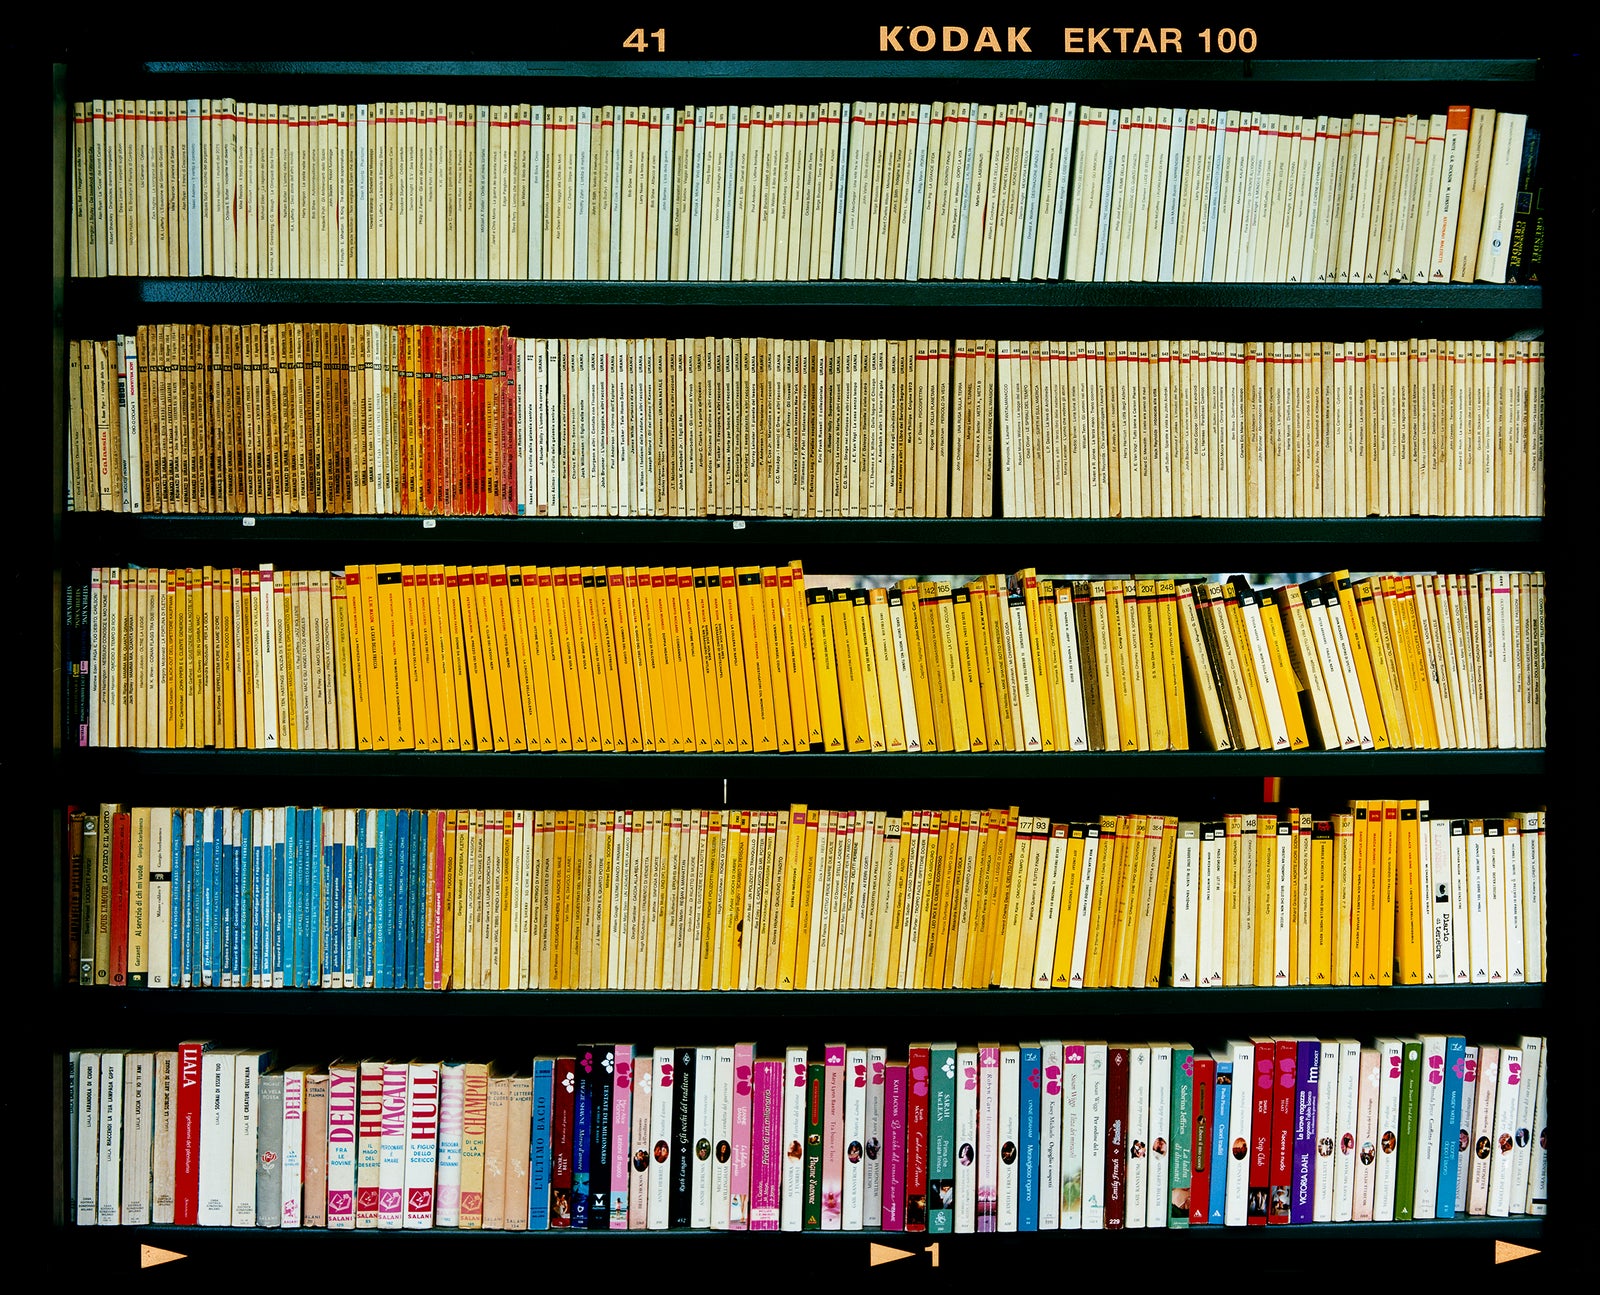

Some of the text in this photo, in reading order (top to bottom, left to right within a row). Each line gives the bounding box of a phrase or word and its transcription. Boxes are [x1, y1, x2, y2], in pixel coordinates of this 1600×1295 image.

[623, 29, 667, 53] 41
[880, 25, 1258, 53] KODAK EKTAR 100
[937, 585, 950, 593] 165
[1141, 585, 1153, 593] 207
[888, 825, 900, 833] 173
[1020, 821, 1032, 830] 177
[1036, 821, 1047, 830] 93
[1102, 820, 1115, 829] 288
[102, 874, 108, 883] LO
[136, 881, 143, 889] mi
[135, 890, 143, 899] chi
[135, 907, 143, 929] servizio
[183, 1049, 197, 1088] LIALA
[681, 1072, 689, 1102] traditore
[285, 1077, 301, 1120] DELLY
[330, 1073, 355, 1143] DELLY
[360, 1067, 384, 1137] HULL
[411, 1069, 439, 1139] HULL
[464, 1070, 488, 1135] CHAMPOL
[680, 1114, 688, 1132] occhi
[1179, 1111, 1187, 1135] Jeffries
[1297, 1116, 1305, 1131] brave
[535, 1096, 545, 1191] L'ULTIMO BACIO
[1257, 1137, 1265, 1152] Strip
[1297, 1132, 1304, 1140] Le
[1299, 1153, 1309, 1205] VICTORIA DAHL
[924, 1242, 939, 1267] 1
